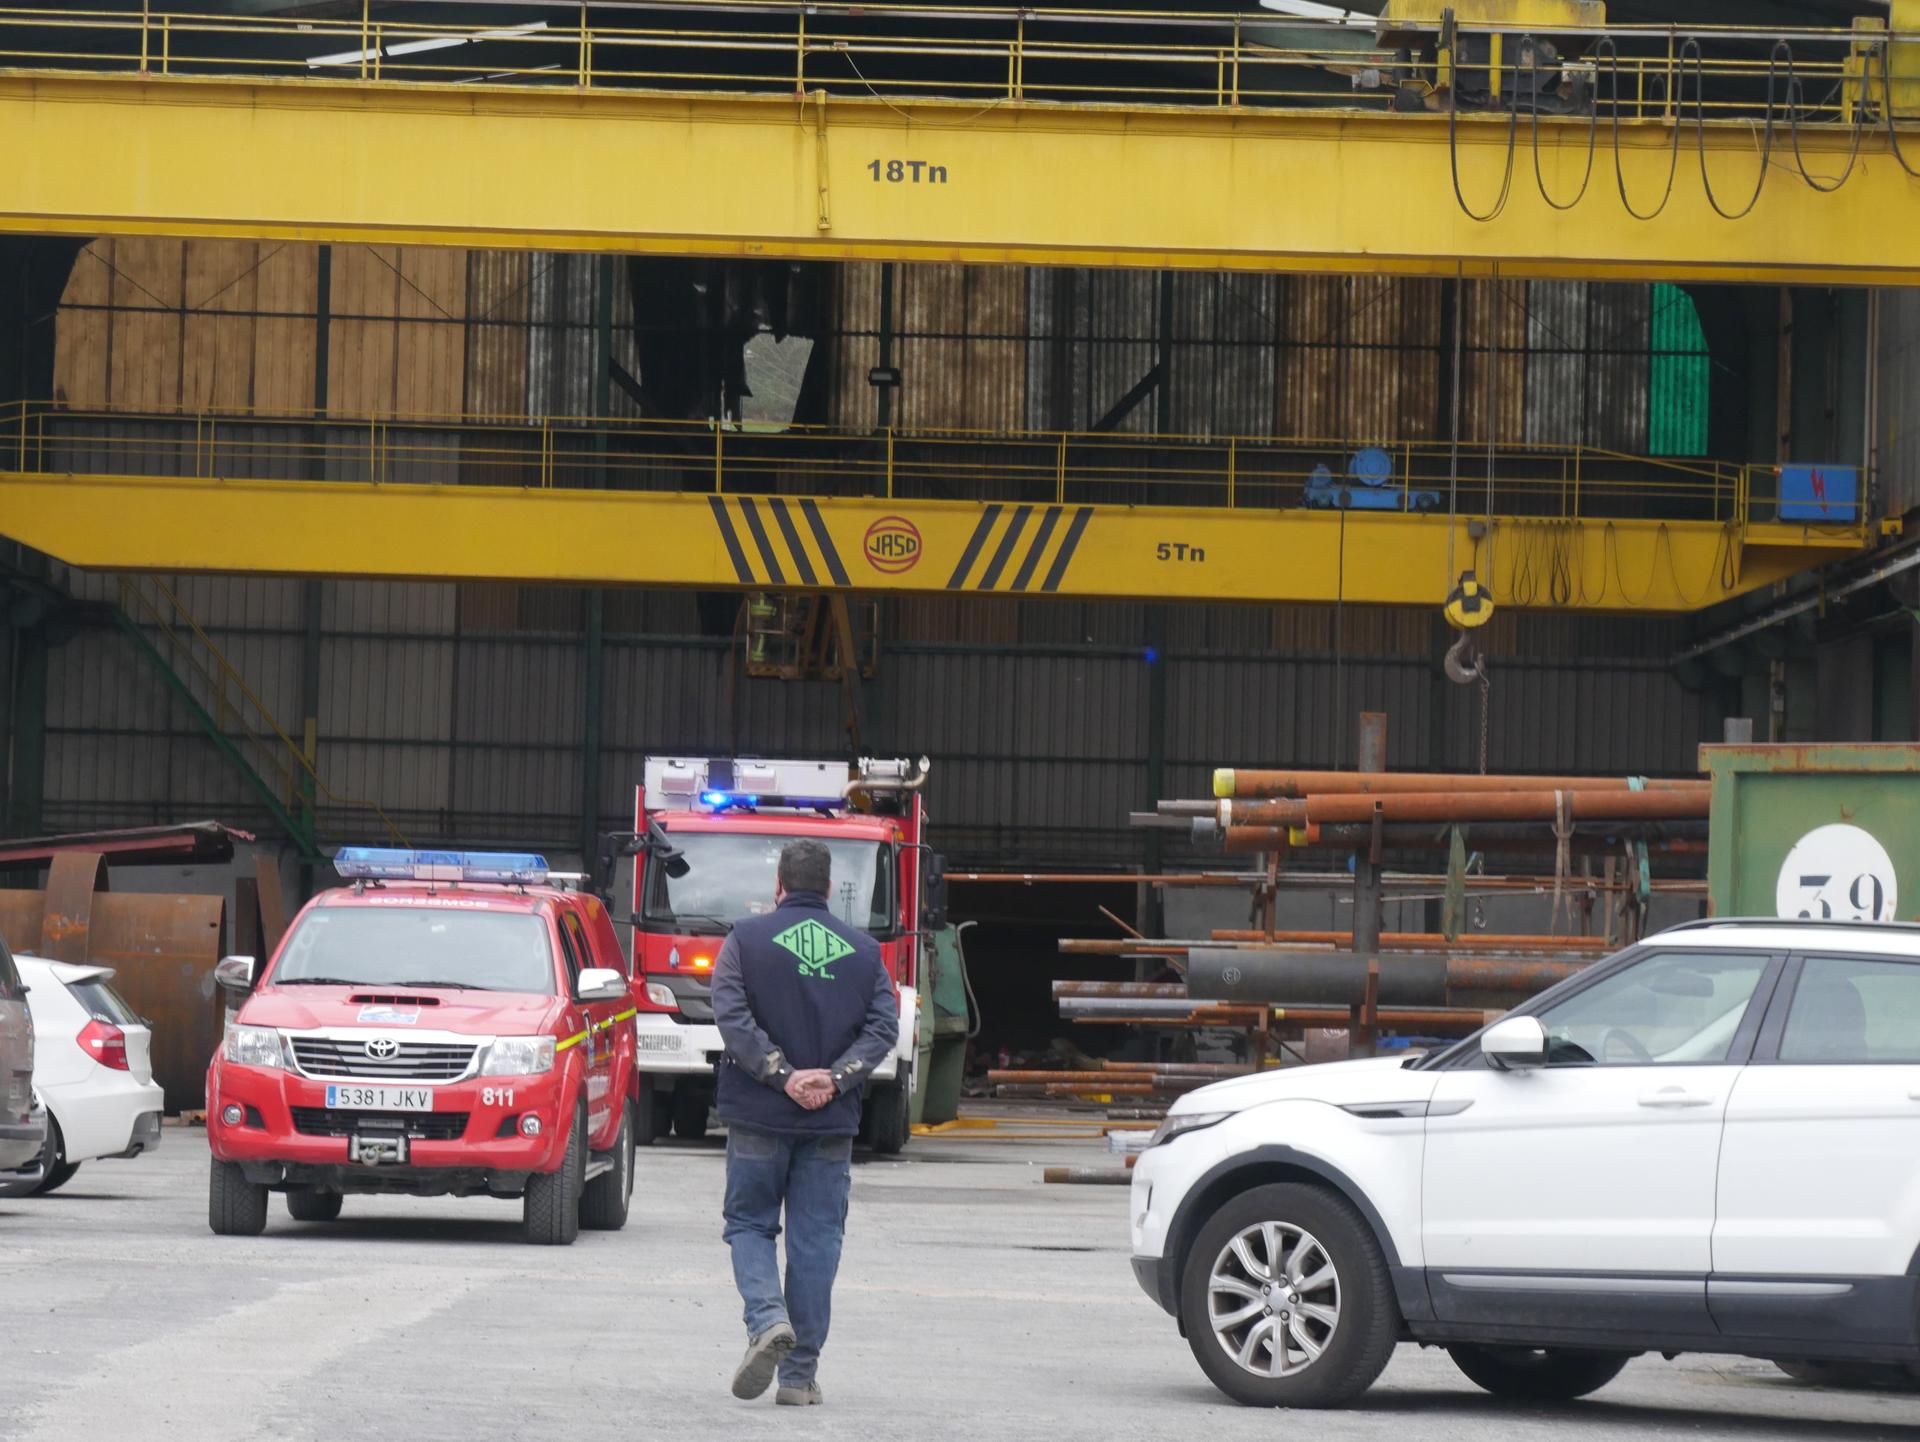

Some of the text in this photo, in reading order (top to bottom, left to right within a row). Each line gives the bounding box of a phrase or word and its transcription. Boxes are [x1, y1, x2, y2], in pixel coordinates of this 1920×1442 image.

[867, 159, 947, 184] 18Tn
[868, 534, 917, 557] JASO
[1156, 543, 1205, 562] 5Tn
[1798, 873, 1883, 921] 39
[340, 1089, 384, 1106] 5381
[393, 1089, 428, 1107] JKV
[482, 1088, 514, 1107] 811
